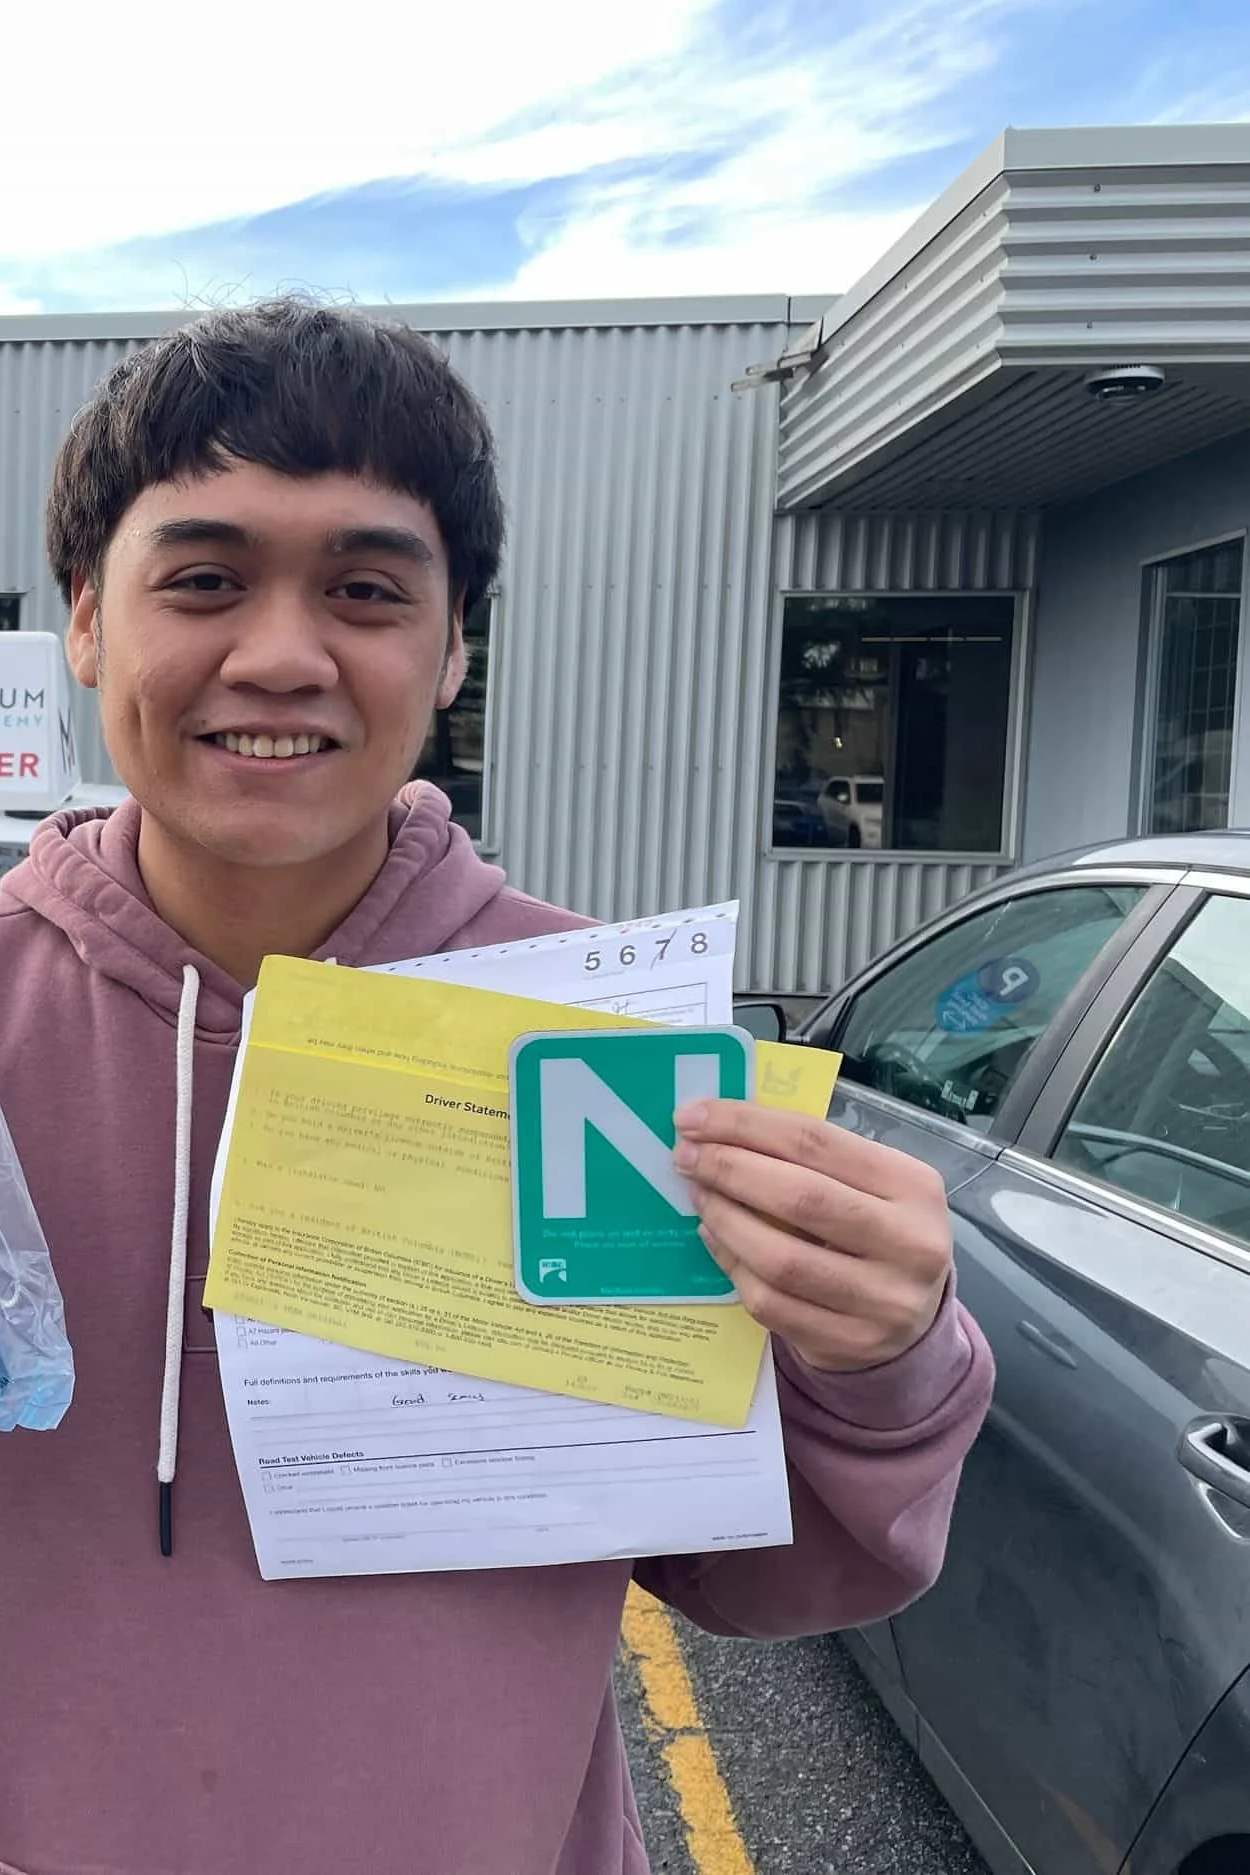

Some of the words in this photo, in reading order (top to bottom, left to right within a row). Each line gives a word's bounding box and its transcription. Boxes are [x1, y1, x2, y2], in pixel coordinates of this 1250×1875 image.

[584, 951, 601, 971] 5
[619, 944, 636, 966] 6
[654, 938, 671, 961] 7
[691, 932, 708, 954] 8
[425, 1094, 461, 1110] Driver
[540, 1054, 720, 1219] N
[260, 1376, 301, 1386] definitions
[302, 1375, 318, 1385] and
[319, 1372, 373, 1384] requirements
[374, 1370, 384, 1379] of
[385, 1369, 398, 1378] the
[259, 1457, 281, 1466] Road
[282, 1456, 299, 1464] Test
[300, 1453, 330, 1462] Vehicle
[332, 1450, 365, 1460] Defects
